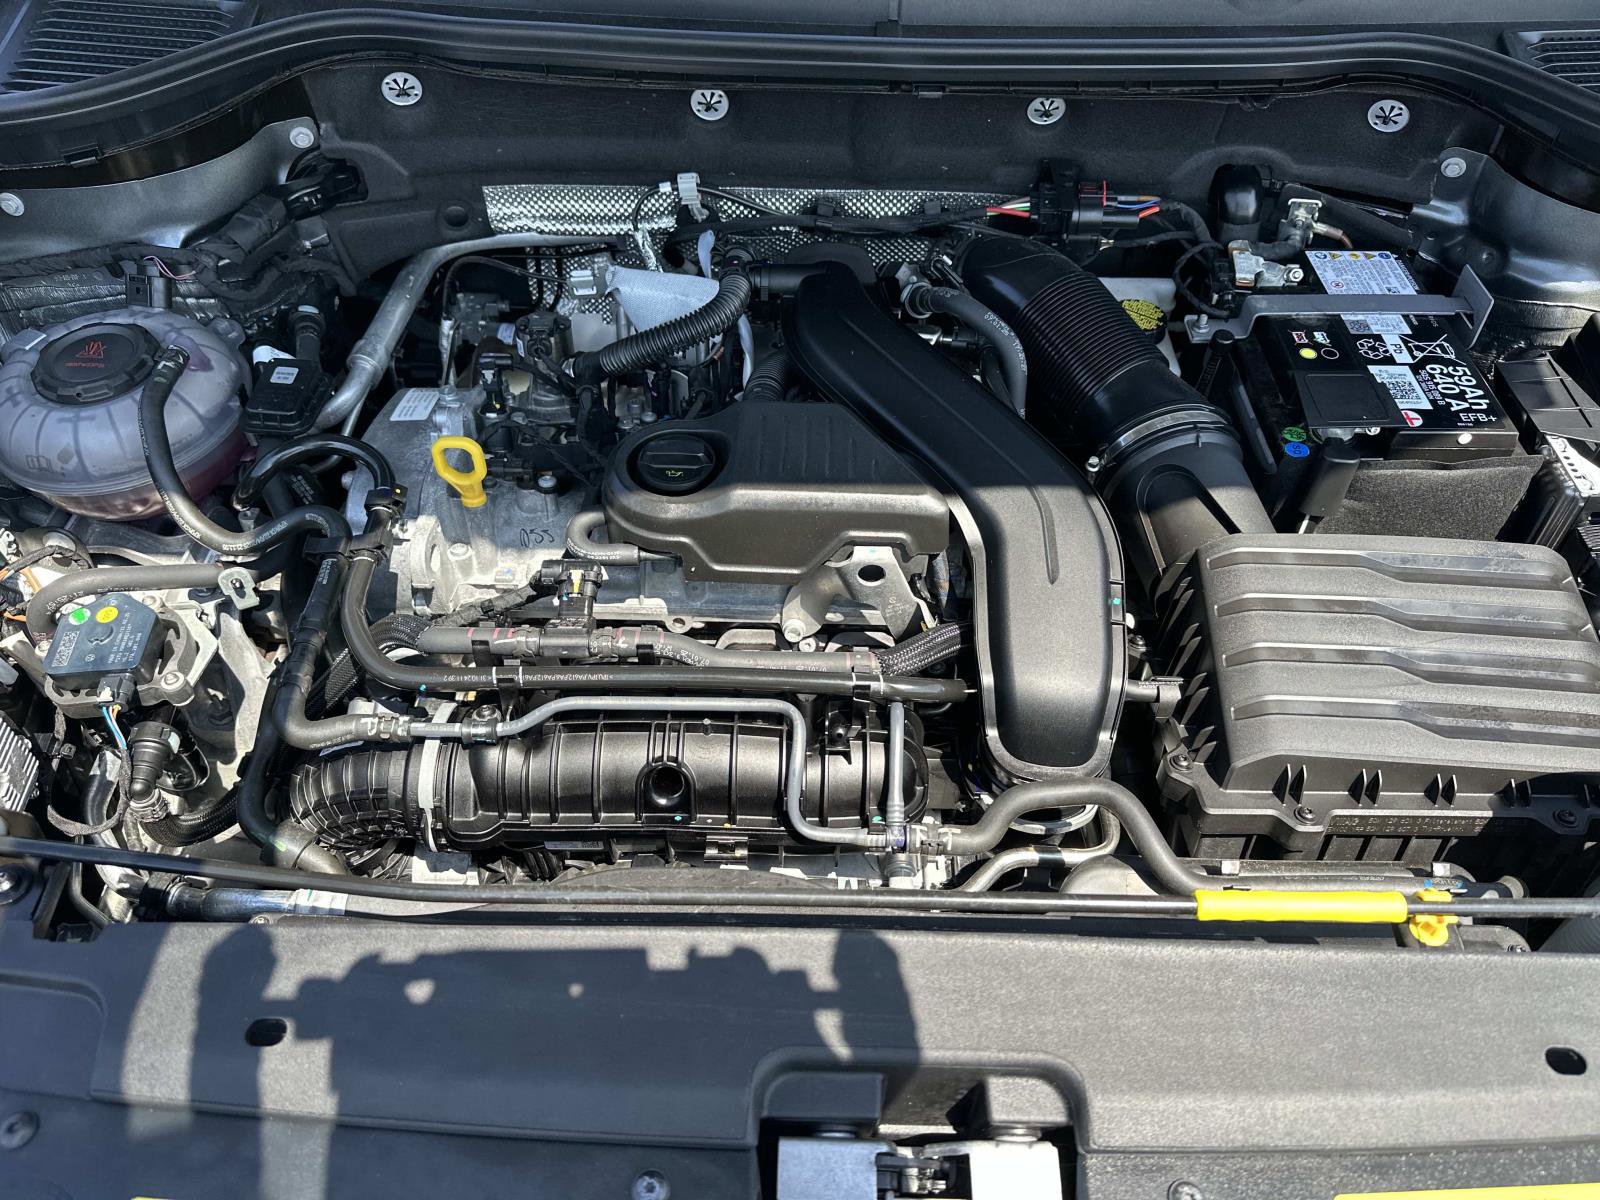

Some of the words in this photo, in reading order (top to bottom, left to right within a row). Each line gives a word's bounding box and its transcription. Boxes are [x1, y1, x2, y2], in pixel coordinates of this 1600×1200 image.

[1389, 343, 1405, 356] Pb
[1426, 364, 1460, 394] 640
[1445, 398, 1470, 411] A
[1448, 366, 1490, 409] 59Ah
[1459, 413, 1497, 422] EFB+
